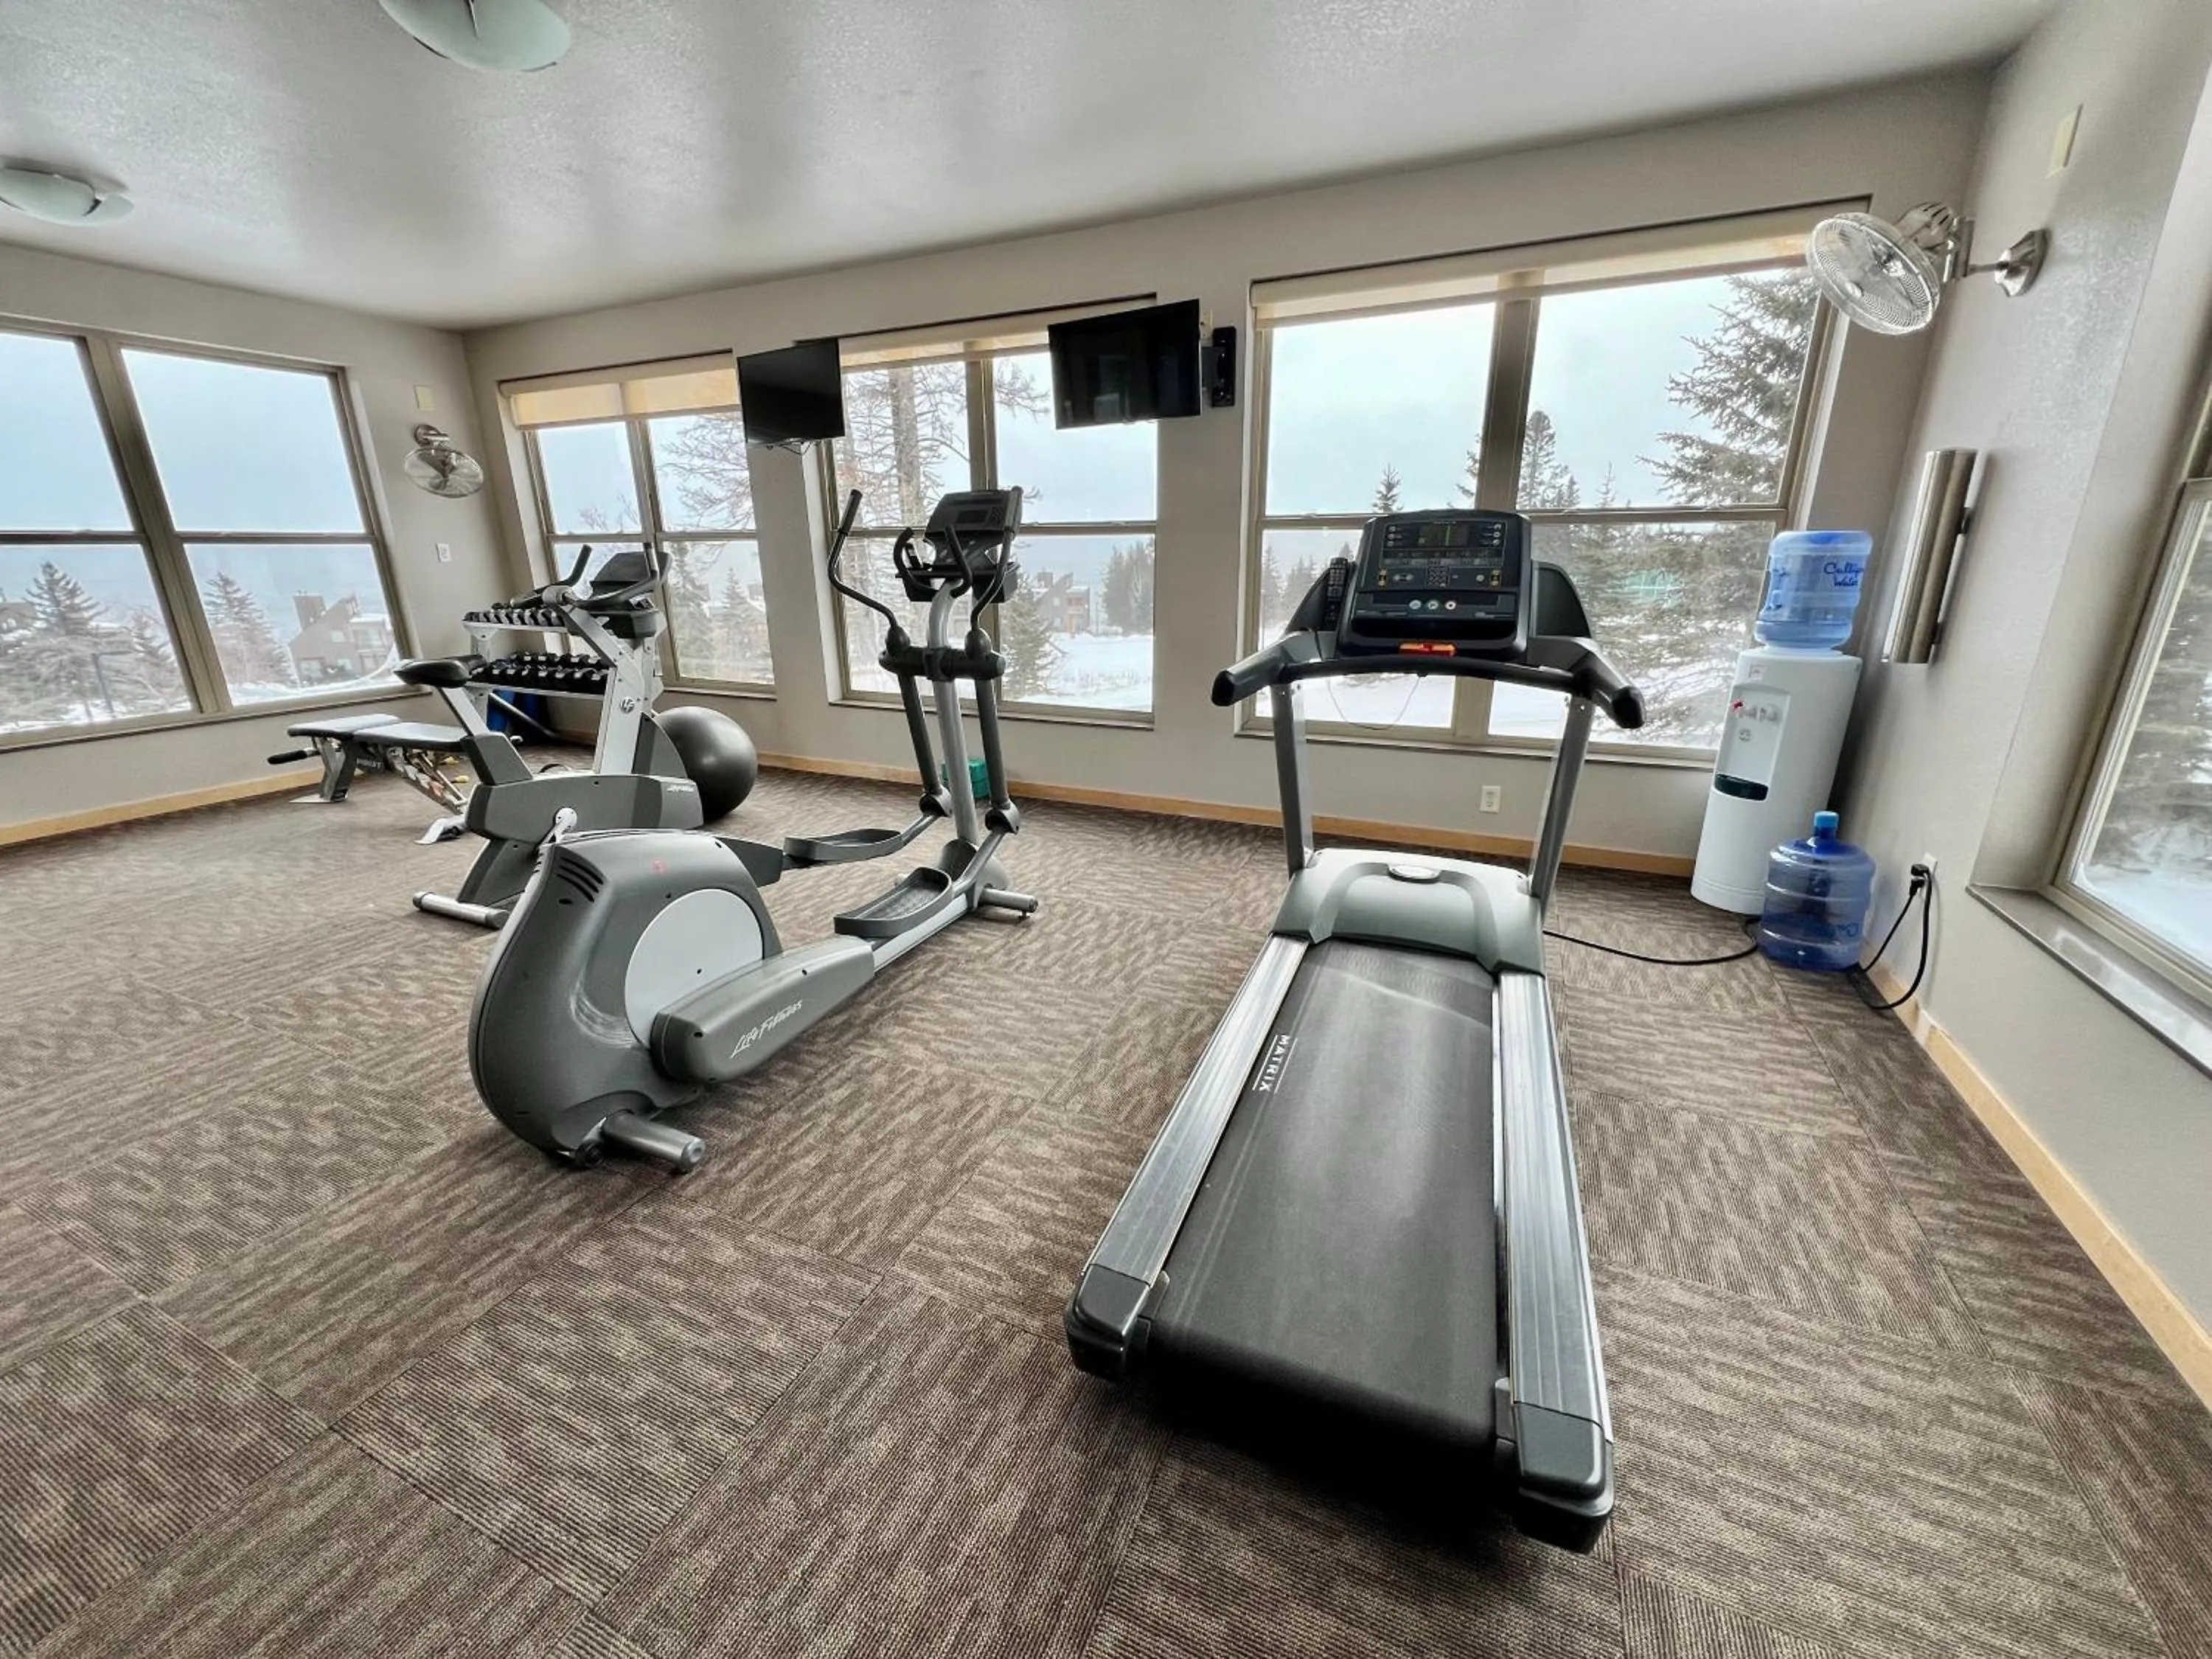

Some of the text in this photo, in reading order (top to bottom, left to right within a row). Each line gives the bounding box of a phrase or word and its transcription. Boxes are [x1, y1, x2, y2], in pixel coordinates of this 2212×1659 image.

[730, 1000, 802, 1059] Life Fitness
[1259, 1034, 1290, 1092] MATRIX
